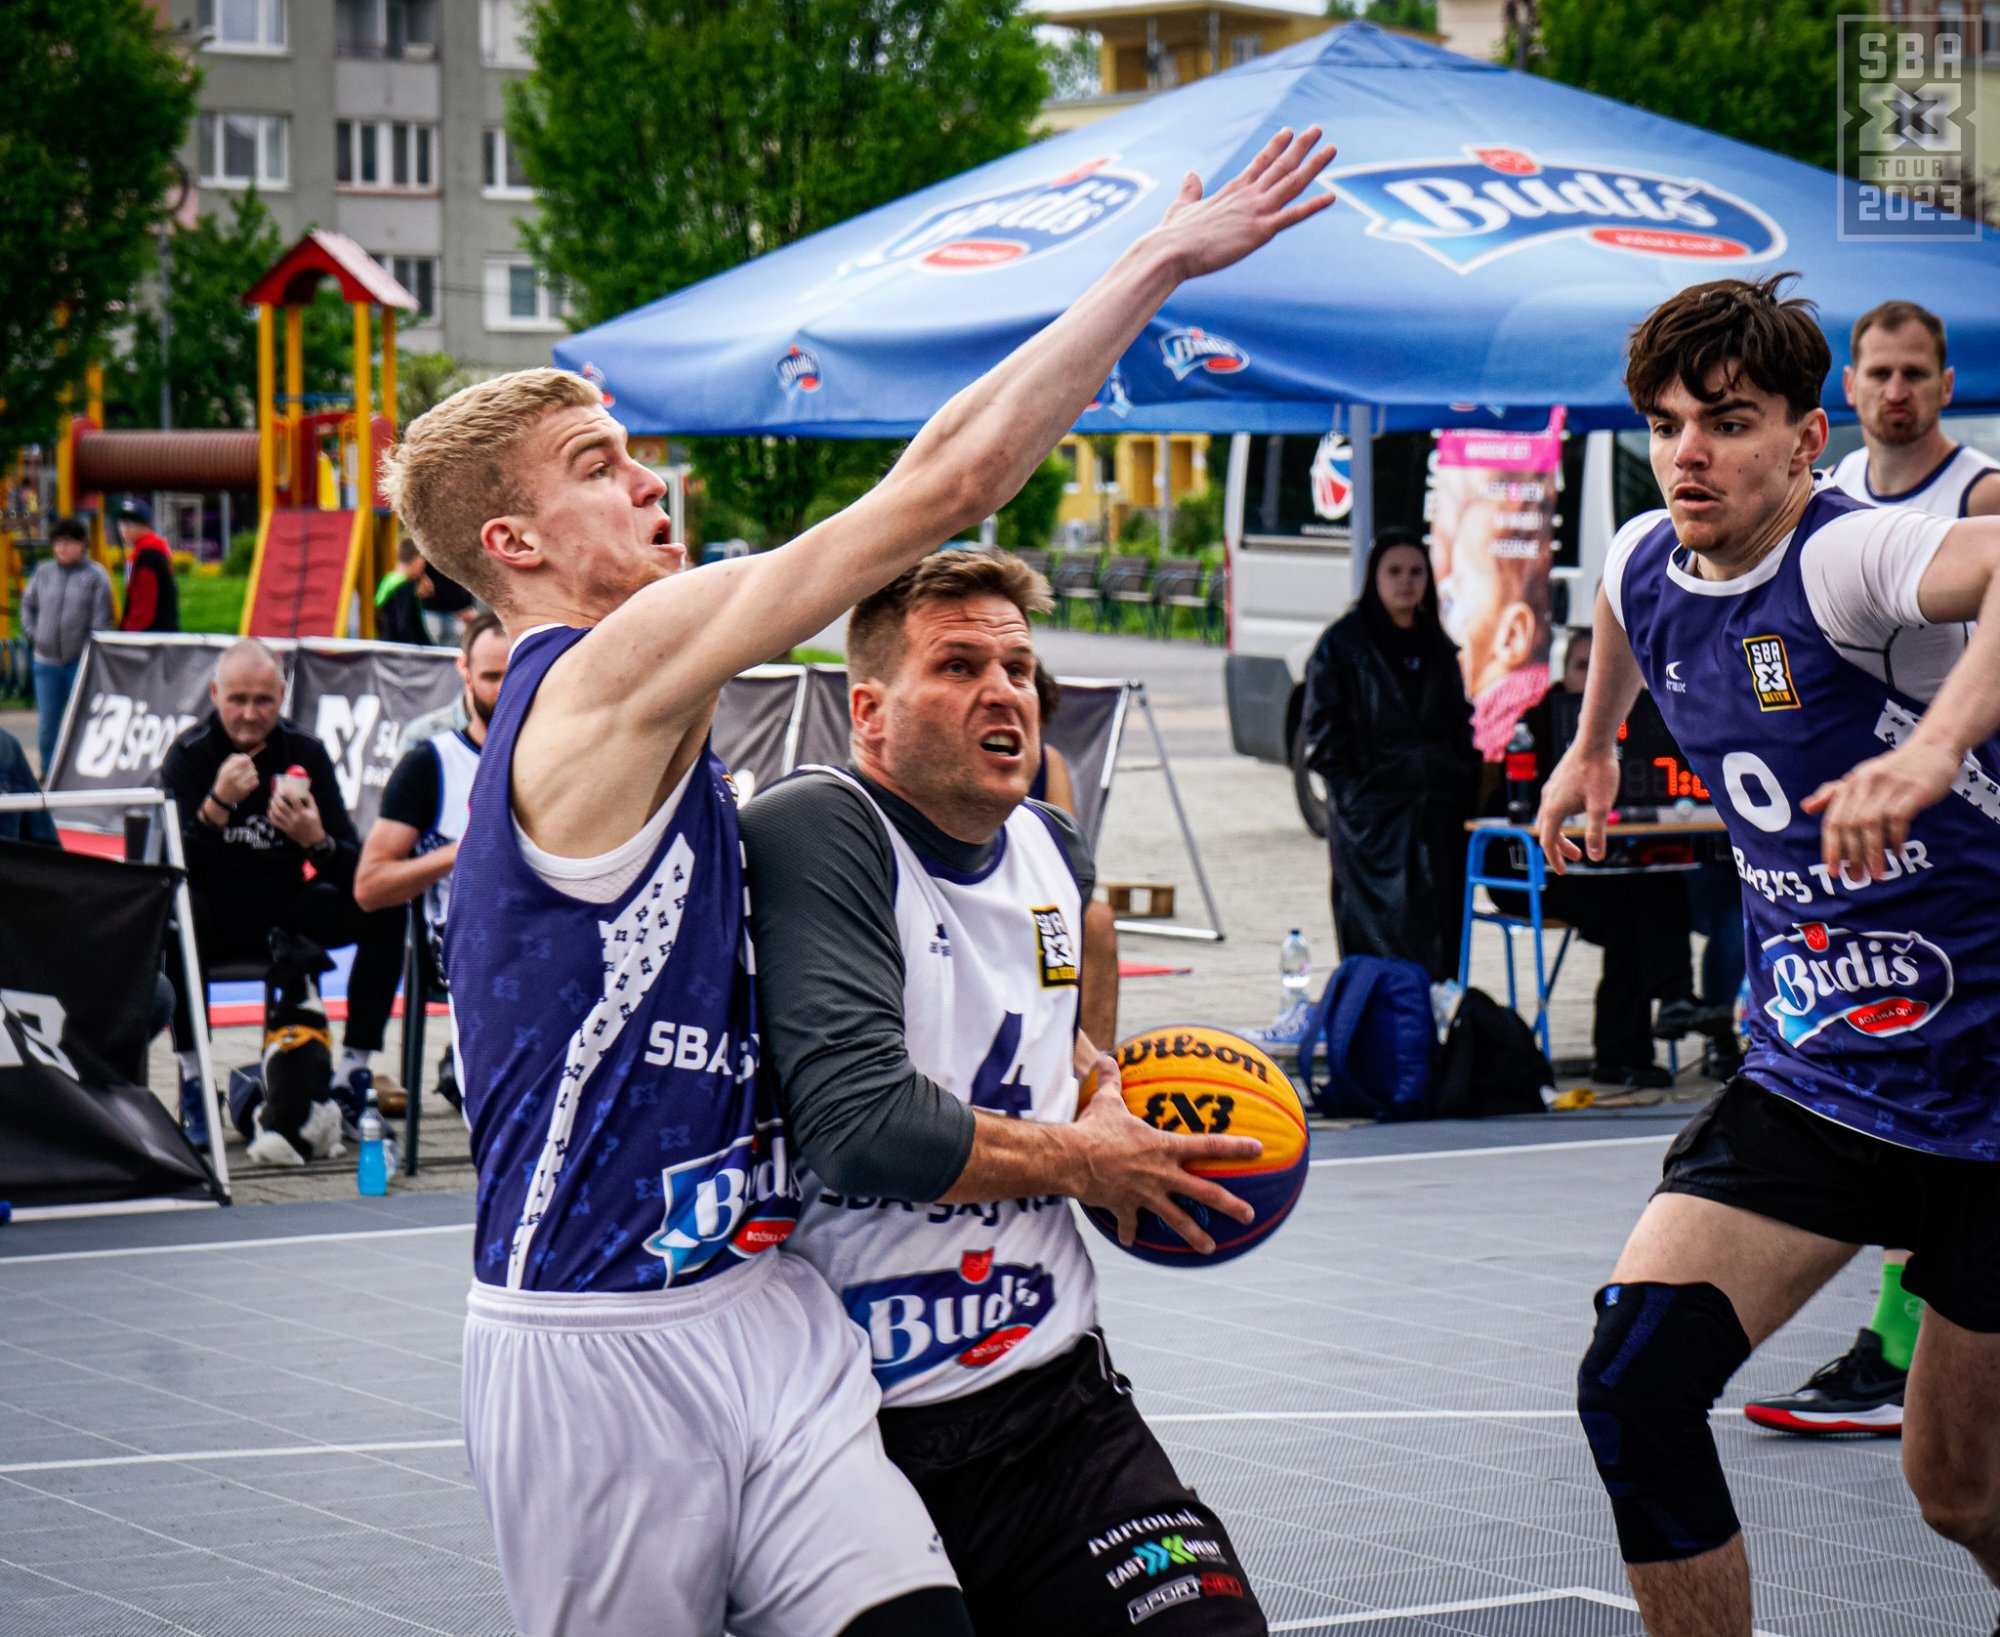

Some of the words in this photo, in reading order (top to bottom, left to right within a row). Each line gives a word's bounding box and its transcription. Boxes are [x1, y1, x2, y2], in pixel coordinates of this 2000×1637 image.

[1751, 641, 1780, 664] SBA
[1723, 751, 1791, 832] 0
[1774, 940, 1919, 1016] Budiš
[645, 1020, 732, 1075] SBA
[970, 1010, 1033, 1119] 4
